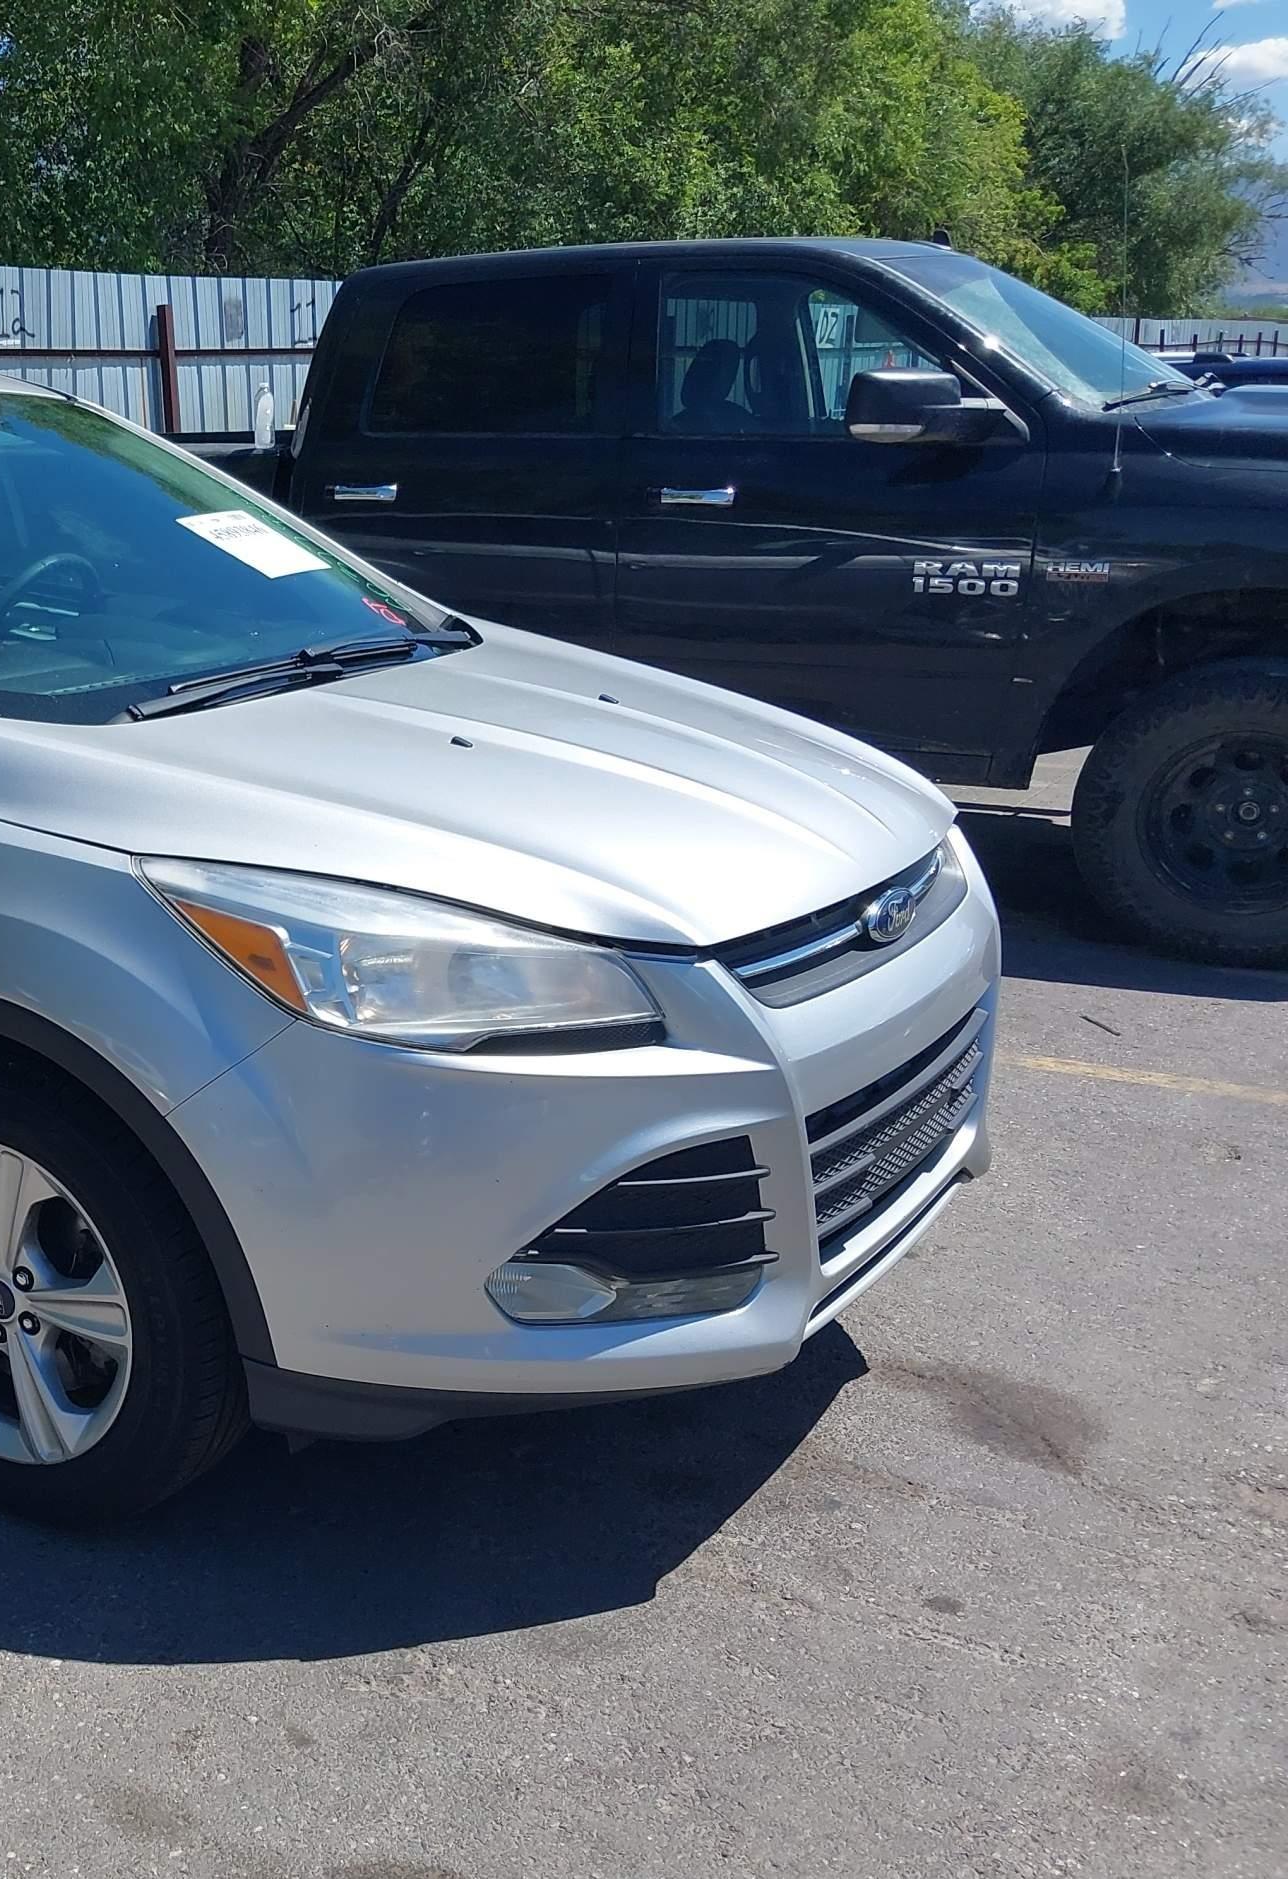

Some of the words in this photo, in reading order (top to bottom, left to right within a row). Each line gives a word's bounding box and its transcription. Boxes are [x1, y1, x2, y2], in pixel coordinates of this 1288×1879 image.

[913, 559, 1022, 578] RAM
[1047, 561, 1111, 573] HEMI
[912, 576, 1020, 597] 1500
[887, 896, 912, 932] Ford
